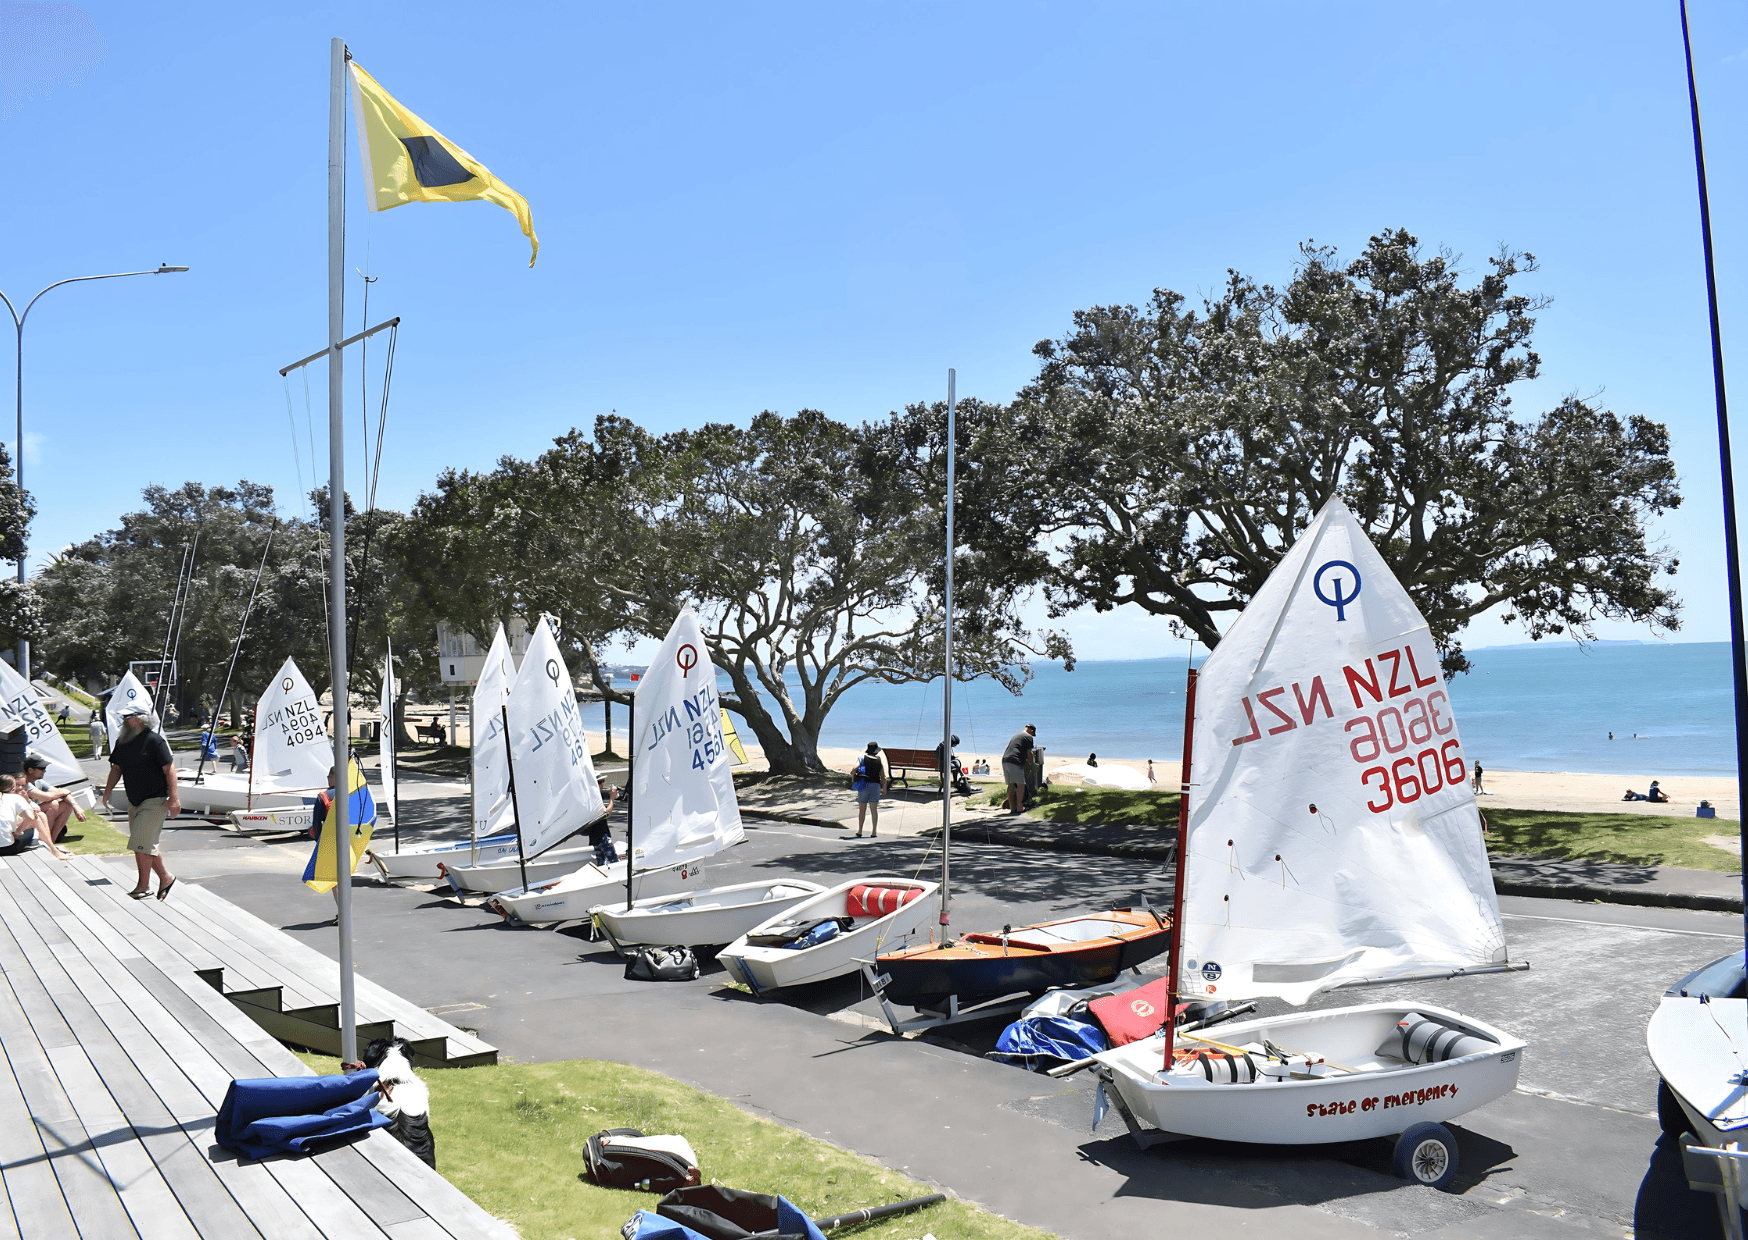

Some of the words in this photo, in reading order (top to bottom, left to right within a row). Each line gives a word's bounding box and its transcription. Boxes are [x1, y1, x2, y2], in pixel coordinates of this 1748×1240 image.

[1342, 645, 1437, 709] NZL
[1, 694, 38, 719] NZL
[285, 700, 315, 718] NZL
[561, 689, 576, 719] NZ
[683, 685, 715, 721] NZL
[287, 725, 323, 747] 4094
[692, 730, 724, 770] 4561
[1361, 739, 1466, 814] 3606
[1206, 963, 1217, 971] N
[1306, 1100, 1357, 1117] State
